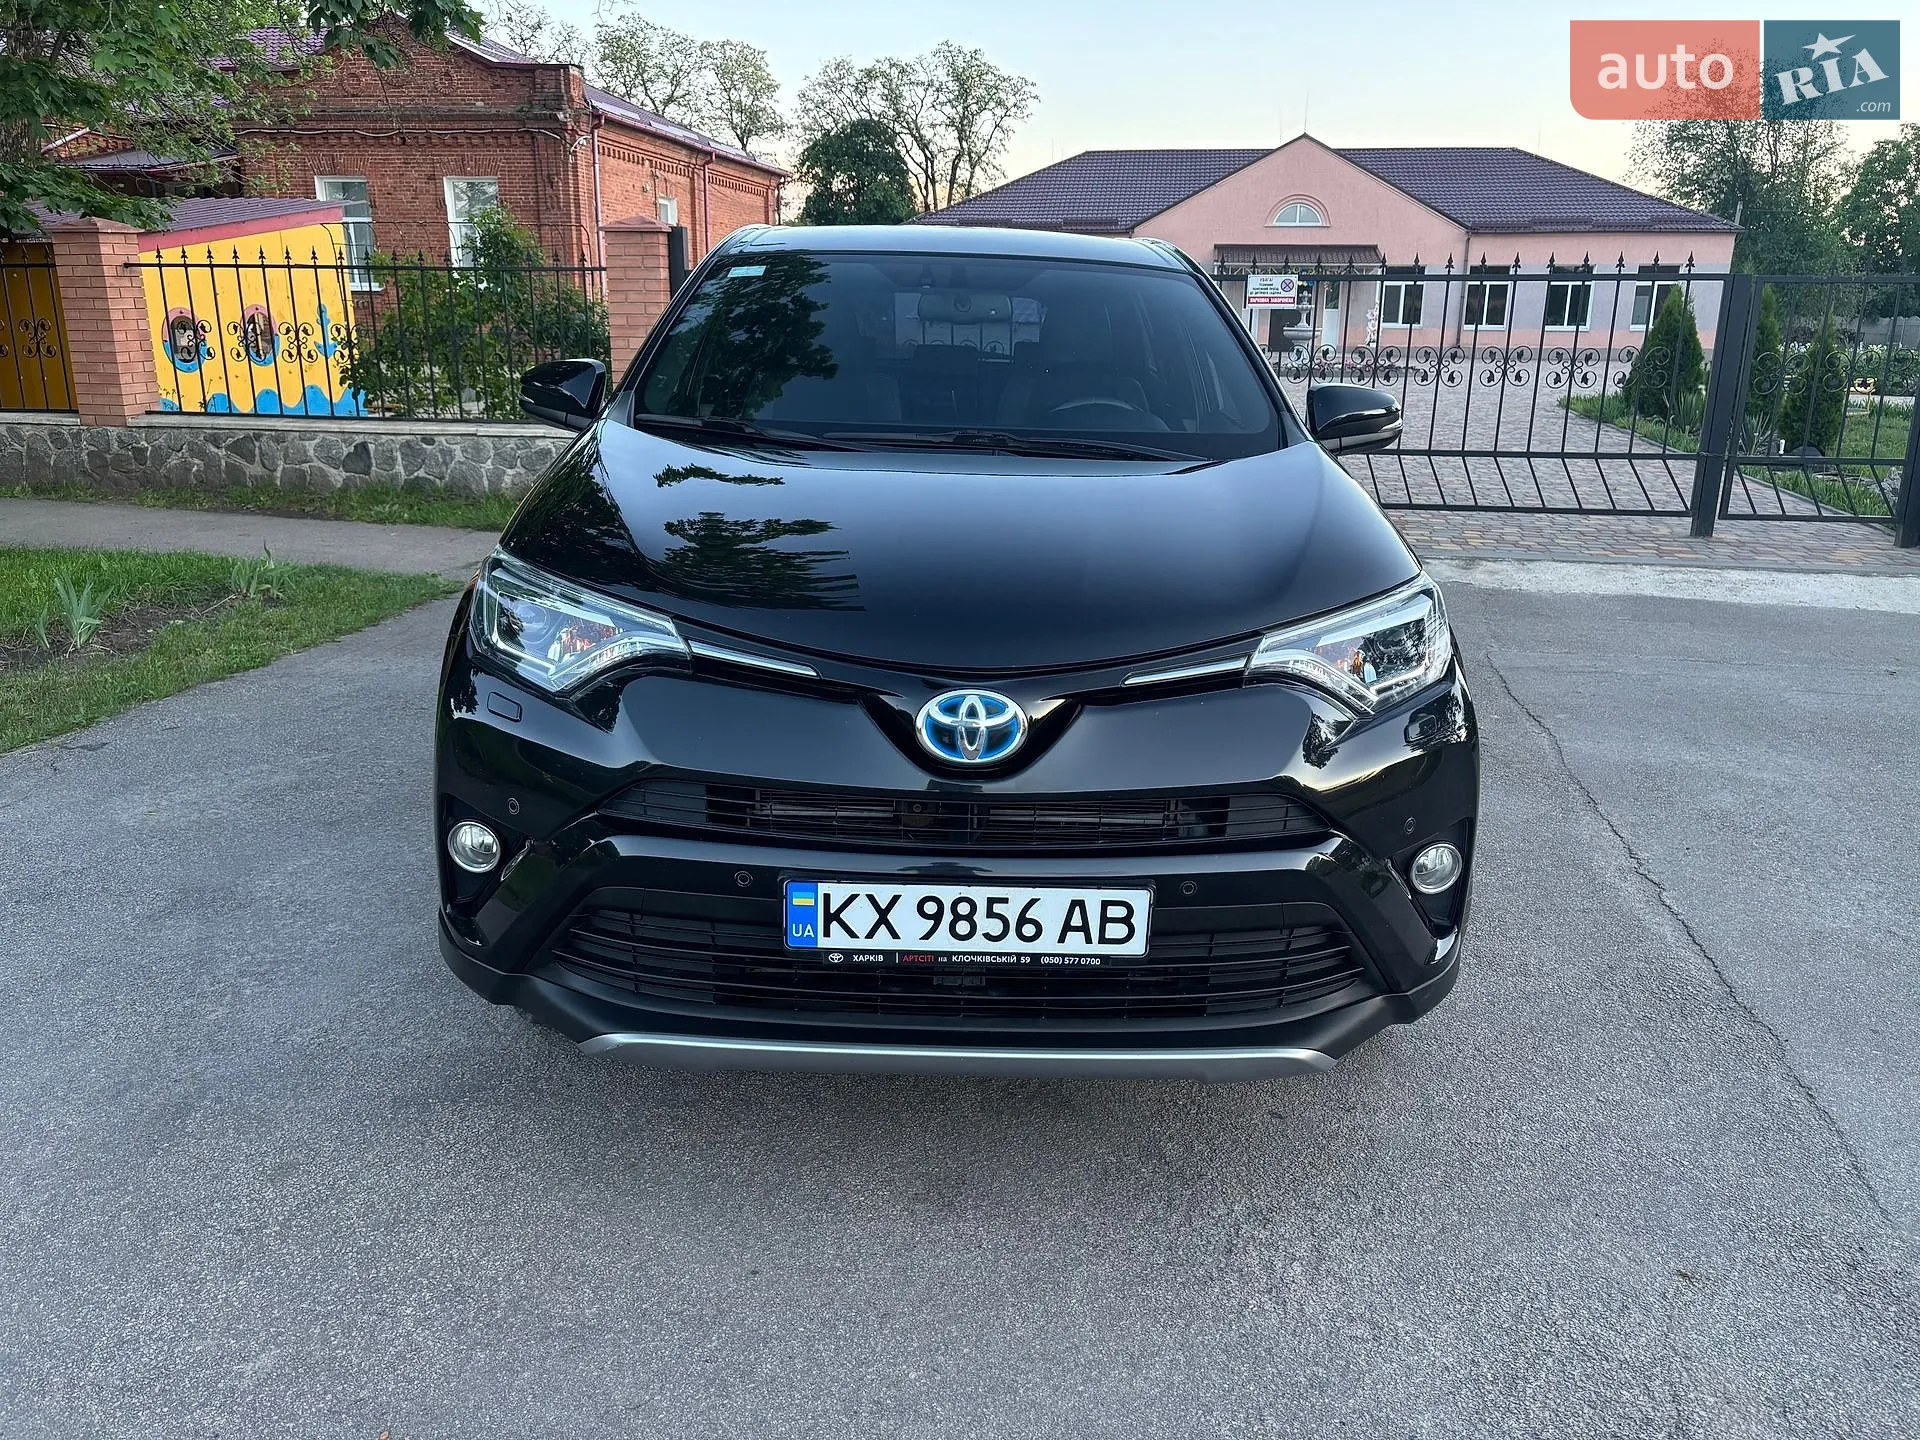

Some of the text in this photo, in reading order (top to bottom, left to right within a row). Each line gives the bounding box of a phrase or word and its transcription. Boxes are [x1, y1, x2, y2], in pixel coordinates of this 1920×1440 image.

[823, 892, 1136, 945] KX 9856 AB
[792, 923, 815, 938] UA
[852, 954, 884, 962] ХАРКІВ
[952, 954, 1017, 963] КЛОЧКІВСЬКІЙ
[1020, 956, 1031, 964] 59
[1040, 956, 1063, 965] (050)
[1064, 957, 1079, 965] 577
[1081, 957, 1101, 966] 0700
